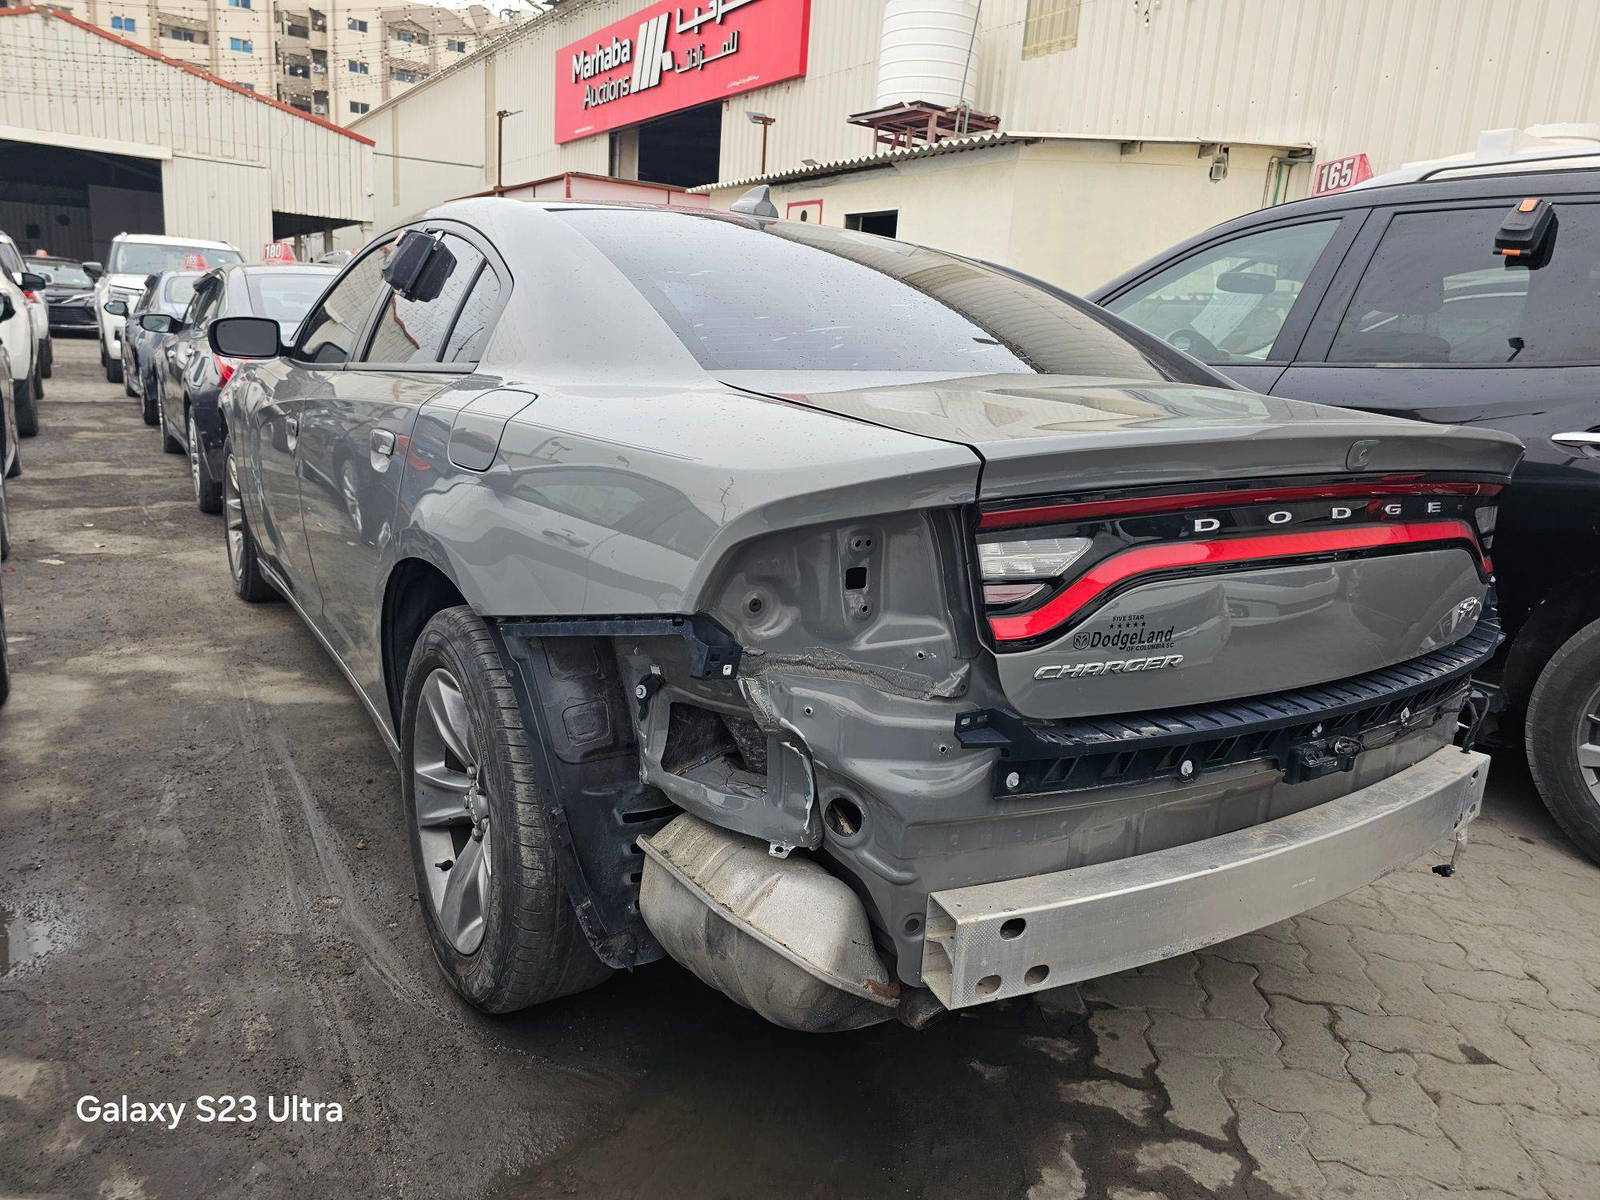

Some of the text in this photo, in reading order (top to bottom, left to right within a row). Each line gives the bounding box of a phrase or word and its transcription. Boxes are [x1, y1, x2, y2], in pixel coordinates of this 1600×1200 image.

[572, 36, 632, 84] Marhaba
[584, 75, 632, 110] Auctions
[1320, 159, 1354, 193] 165
[265, 244, 282, 259] 180
[1194, 501, 1442, 532] DODGE
[1090, 625, 1175, 650] DodgeLand
[1135, 643, 1165, 651] COLUMBIA
[1034, 655, 1183, 680] CHARGER
